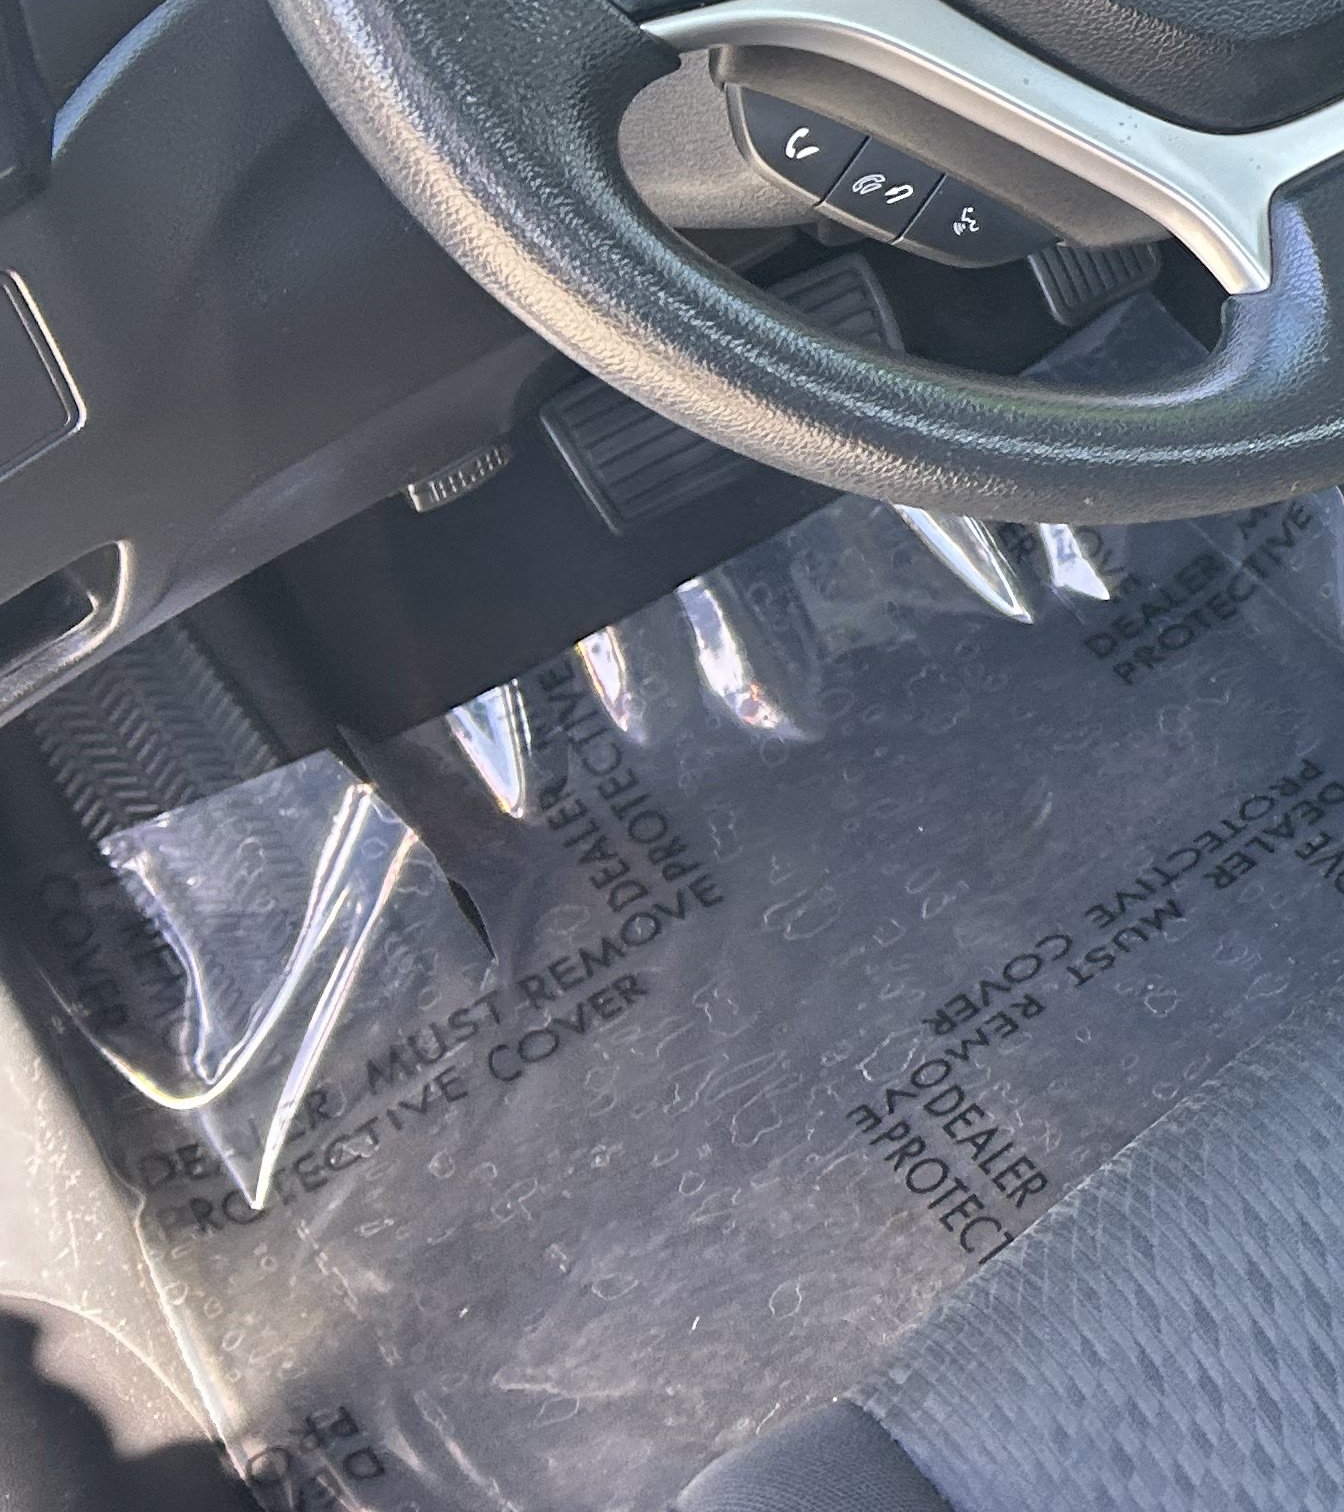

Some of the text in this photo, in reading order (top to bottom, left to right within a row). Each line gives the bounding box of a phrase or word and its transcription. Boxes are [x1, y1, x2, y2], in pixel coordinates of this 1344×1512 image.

[538, 774, 649, 913] DEALER
[922, 759, 1324, 1036] PROTECTIVE COVER
[365, 989, 505, 1095] MUST
[515, 873, 725, 1011] REMOVE
[1066, 898, 1185, 988] MUST
[487, 971, 650, 1082] COVER
[845, 993, 1046, 1133] REMOVE
[869, 1120, 1015, 1266] PROTECT
[923, 1085, 1048, 1208] DEALER
